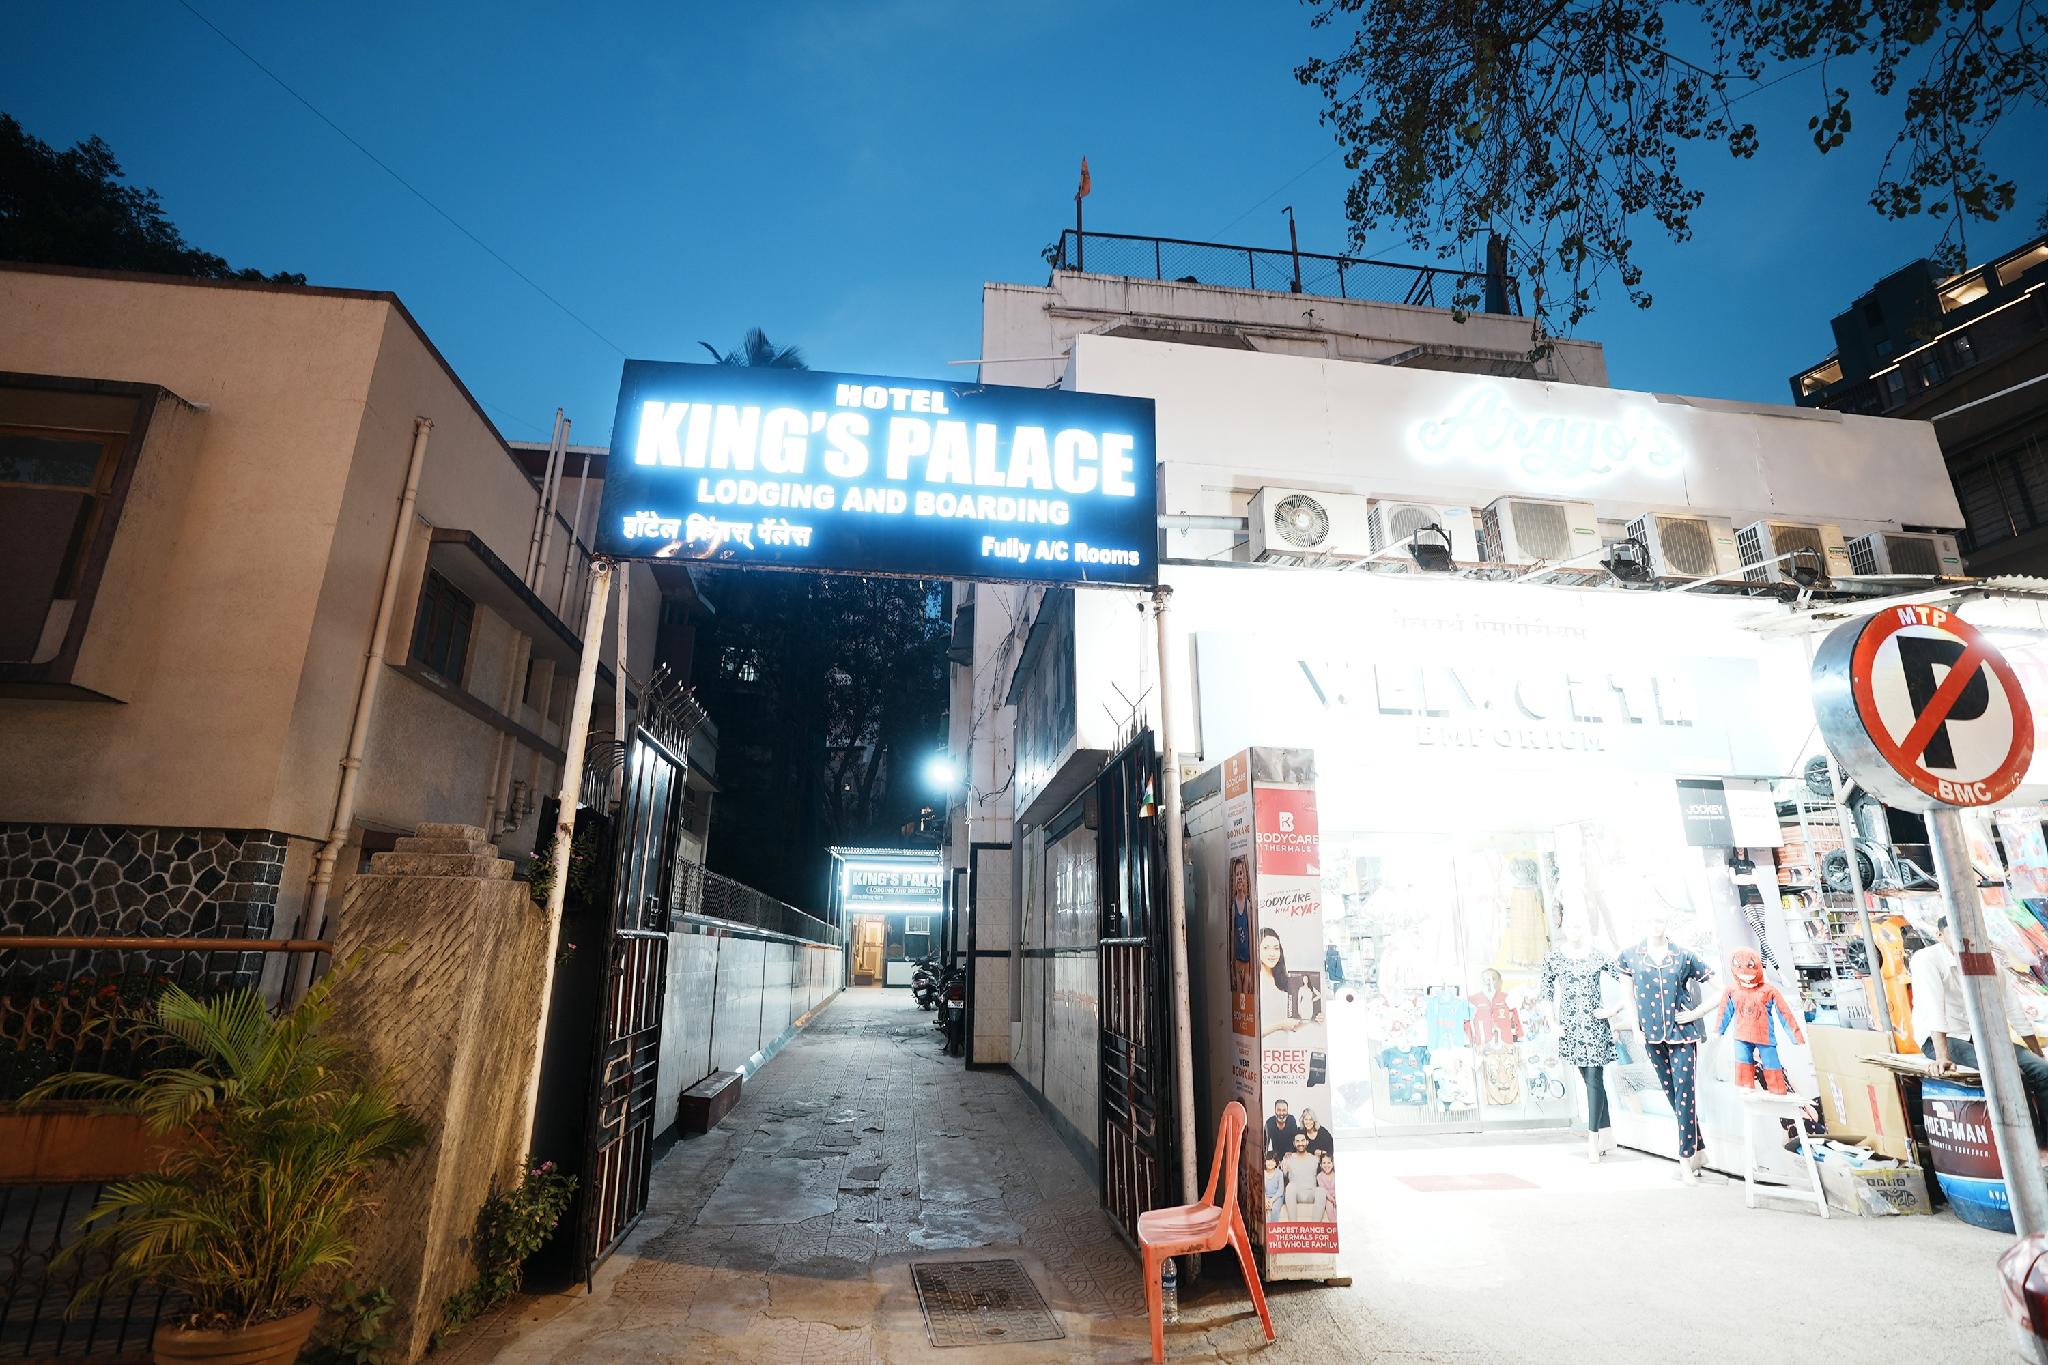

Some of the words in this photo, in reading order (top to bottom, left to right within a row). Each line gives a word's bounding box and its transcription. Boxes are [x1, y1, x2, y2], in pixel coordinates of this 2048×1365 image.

[835, 383, 950, 415] HOTEL
[634, 400, 869, 479] KING'S
[886, 416, 1136, 497] PALACE
[697, 477, 836, 510] LODGING
[841, 486, 908, 514] AND
[914, 491, 1070, 526] BOARDING
[981, 535, 1030, 564] Fully
[1034, 540, 1069, 562] A/C
[1073, 543, 1140, 566] Rooms
[1896, 606, 1947, 627] MTP
[1937, 779, 1992, 805] BMC
[1686, 804, 1723, 815] JOCKEY
[1255, 832, 1320, 845] BODYCARE
[1263, 844, 1312, 853] THERMALS
[852, 871, 899, 886] KING'S
[1263, 1063, 1306, 1074] SOCKS
[1923, 1114, 1989, 1145] PIDER-MAN
[1268, 1226, 1299, 1234] LARGEST
[1300, 1226, 1325, 1234] RANGE
[1283, 1240, 1309, 1248] WHOLE
[1311, 1241, 1338, 1249] FAMILY
